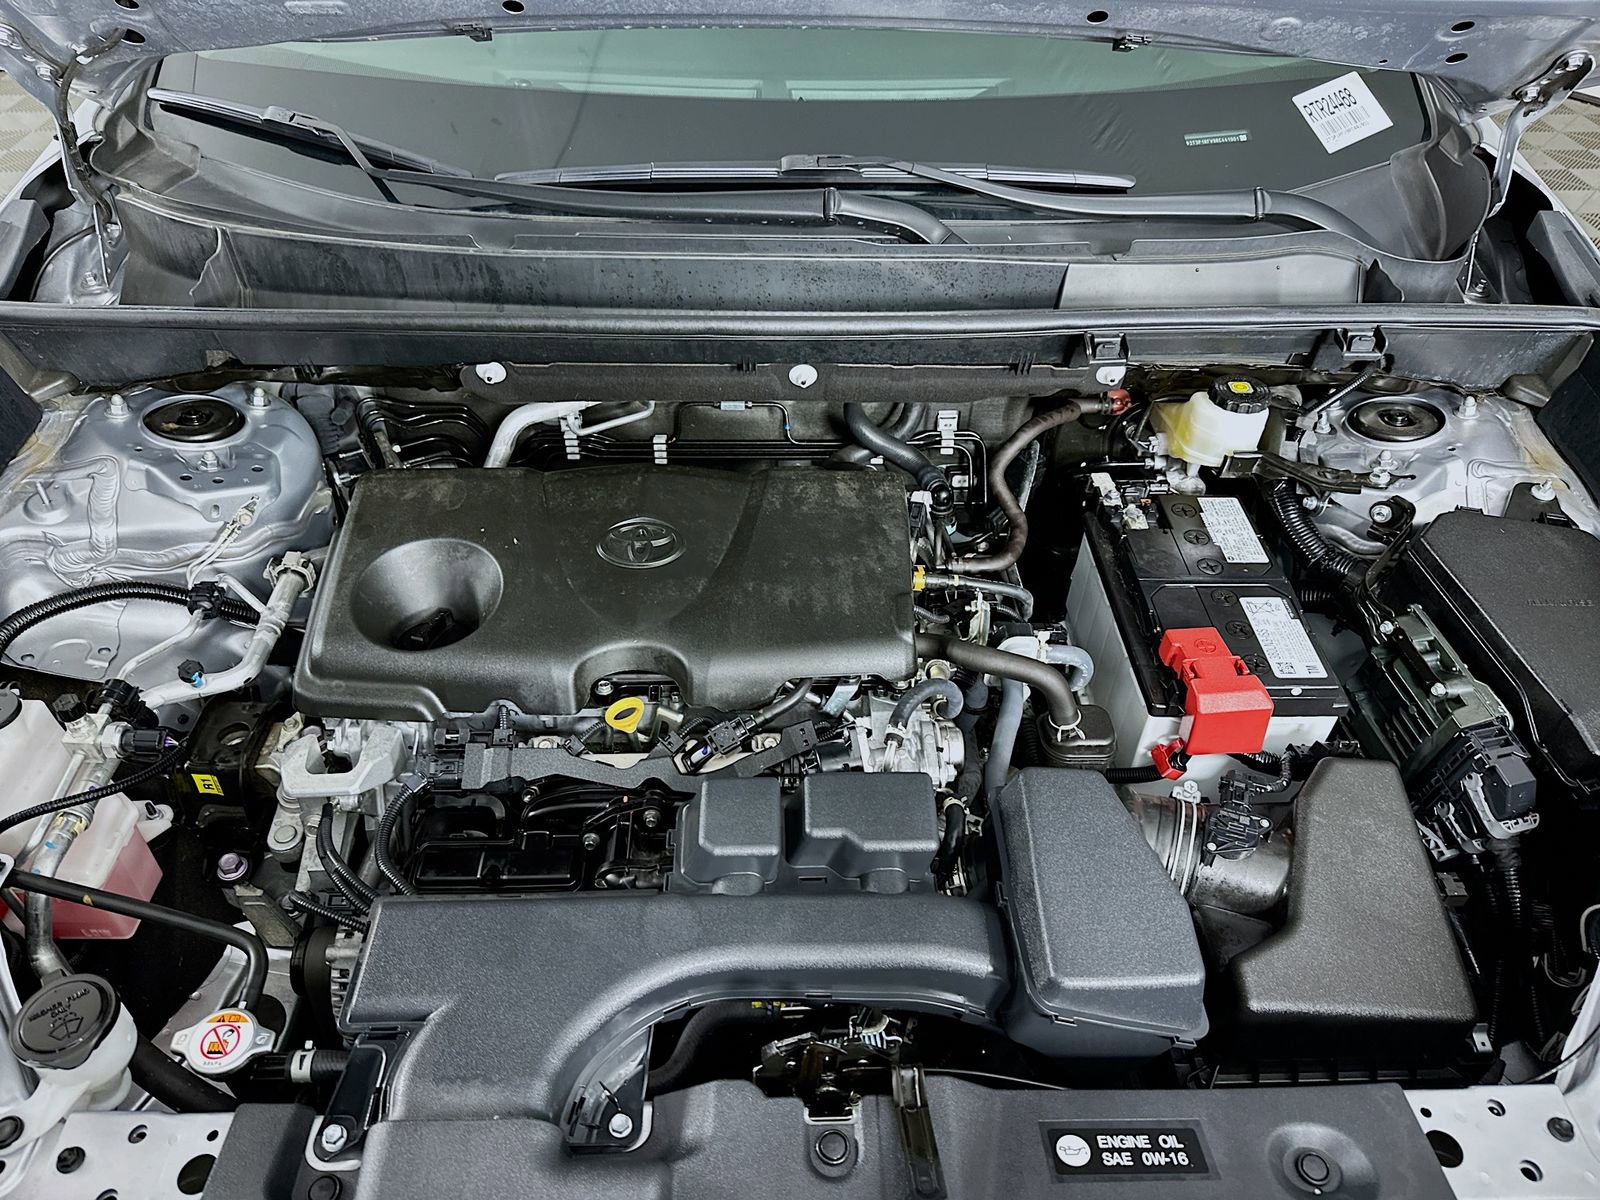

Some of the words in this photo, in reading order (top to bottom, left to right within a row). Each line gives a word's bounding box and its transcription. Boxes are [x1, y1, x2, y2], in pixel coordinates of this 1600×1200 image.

[1303, 87, 1357, 124] RTR24468
[1096, 1135, 1151, 1149] ENGINE
[1158, 1135, 1184, 1149] OIL
[1101, 1152, 1134, 1166] SAE
[1141, 1152, 1189, 1166] 0W-16
